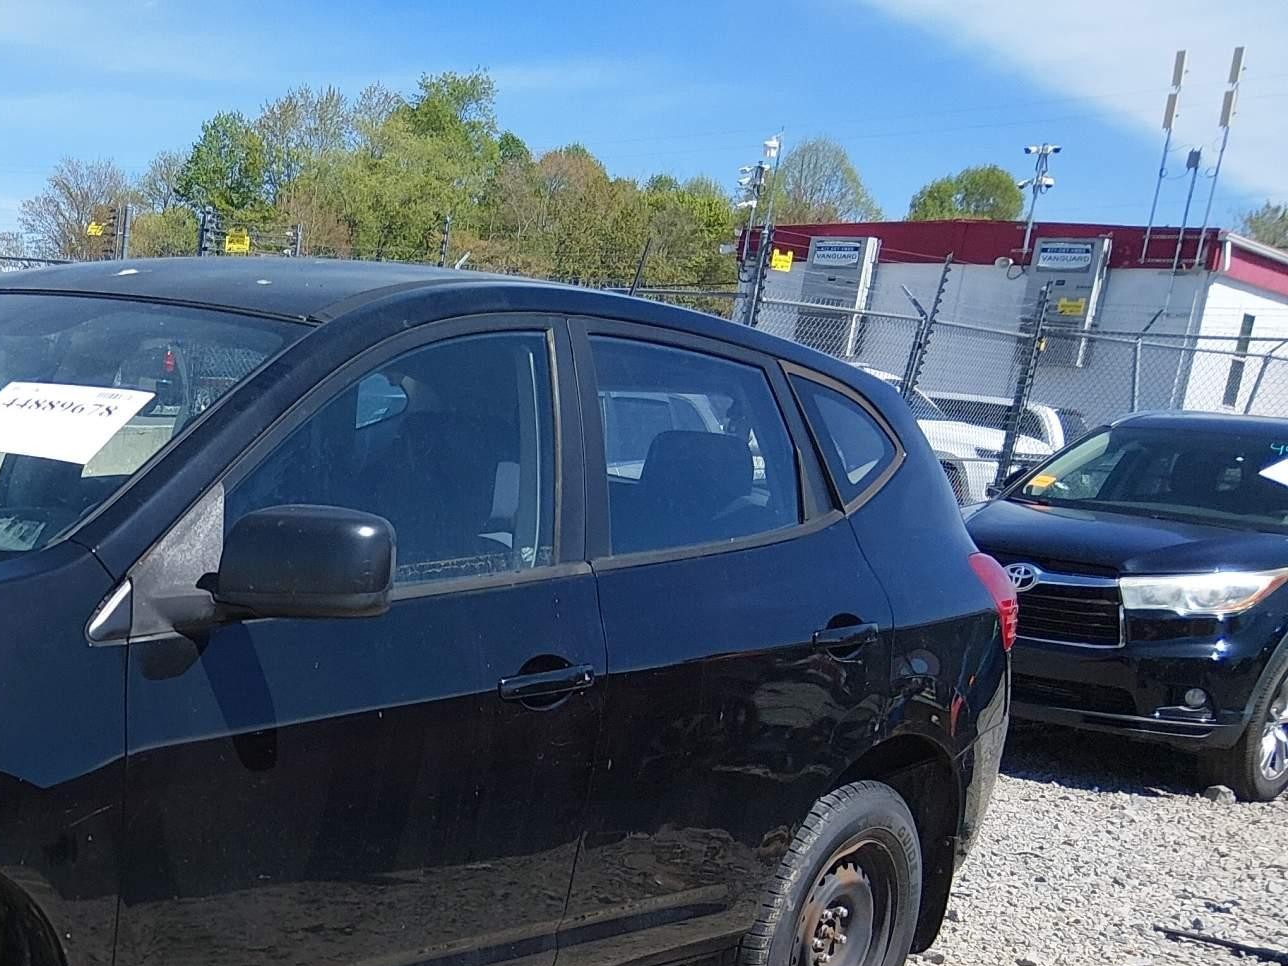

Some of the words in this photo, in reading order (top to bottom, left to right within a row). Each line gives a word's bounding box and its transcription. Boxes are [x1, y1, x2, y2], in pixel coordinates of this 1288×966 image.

[816, 252, 857, 260] VANGUARD
[1041, 255, 1089, 263] VANGUARD
[2, 397, 119, 417] 44889678
